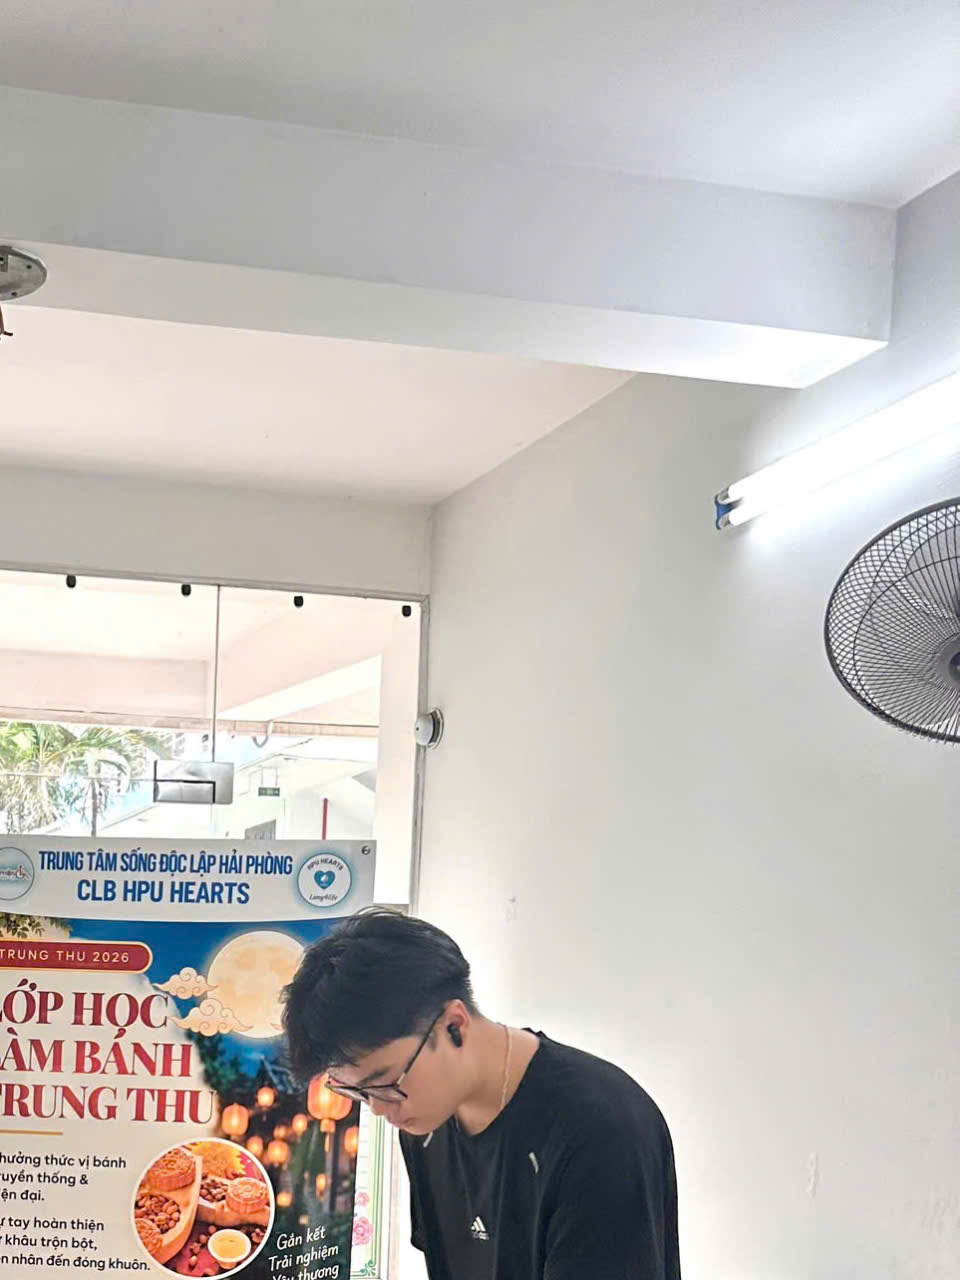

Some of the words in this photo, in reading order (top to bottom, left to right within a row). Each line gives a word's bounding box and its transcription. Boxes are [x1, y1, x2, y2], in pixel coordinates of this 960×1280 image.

[39, 850, 83, 871] TRUNG
[87, 849, 117, 872] TÂM
[120, 848, 156, 873] SỐNG
[159, 851, 187, 878] ĐỘC
[190, 851, 216, 878] LẬP
[219, 849, 241, 874] HẢI
[244, 849, 293, 875] PHÒNG
[77, 879, 116, 901] CLB
[123, 880, 163, 902] HPU
[170, 881, 250, 905] HEARTS
[57, 949, 86, 962] THU
[93, 951, 130, 963] 2026
[71, 991, 168, 1035] HỌC
[71, 1032, 193, 1078] BÁNH
[126, 1087, 217, 1125] THU
[44, 1152, 75, 1167] thức
[78, 1155, 90, 1170] vị
[93, 1155, 127, 1168] bánh
[37, 1170, 76, 1187] thống
[79, 1174, 89, 1185] &
[20, 1188, 45, 1204] đại.
[8, 1217, 30, 1230] tay
[33, 1216, 68, 1230] hoàn
[71, 1217, 105, 1233] thiện
[4, 1232, 38, 1246] khâu
[41, 1235, 68, 1250] trộn
[71, 1235, 98, 1251] bột,
[276, 1232, 303, 1250] Gắn
[306, 1225, 326, 1243] kết
[11, 1253, 44, 1266] nhân
[46, 1252, 70, 1267] đến
[73, 1255, 106, 1271] đóng
[108, 1257, 151, 1271] khuôn.
[268, 1254, 293, 1271] Trải
[295, 1245, 339, 1267] nghiệm
